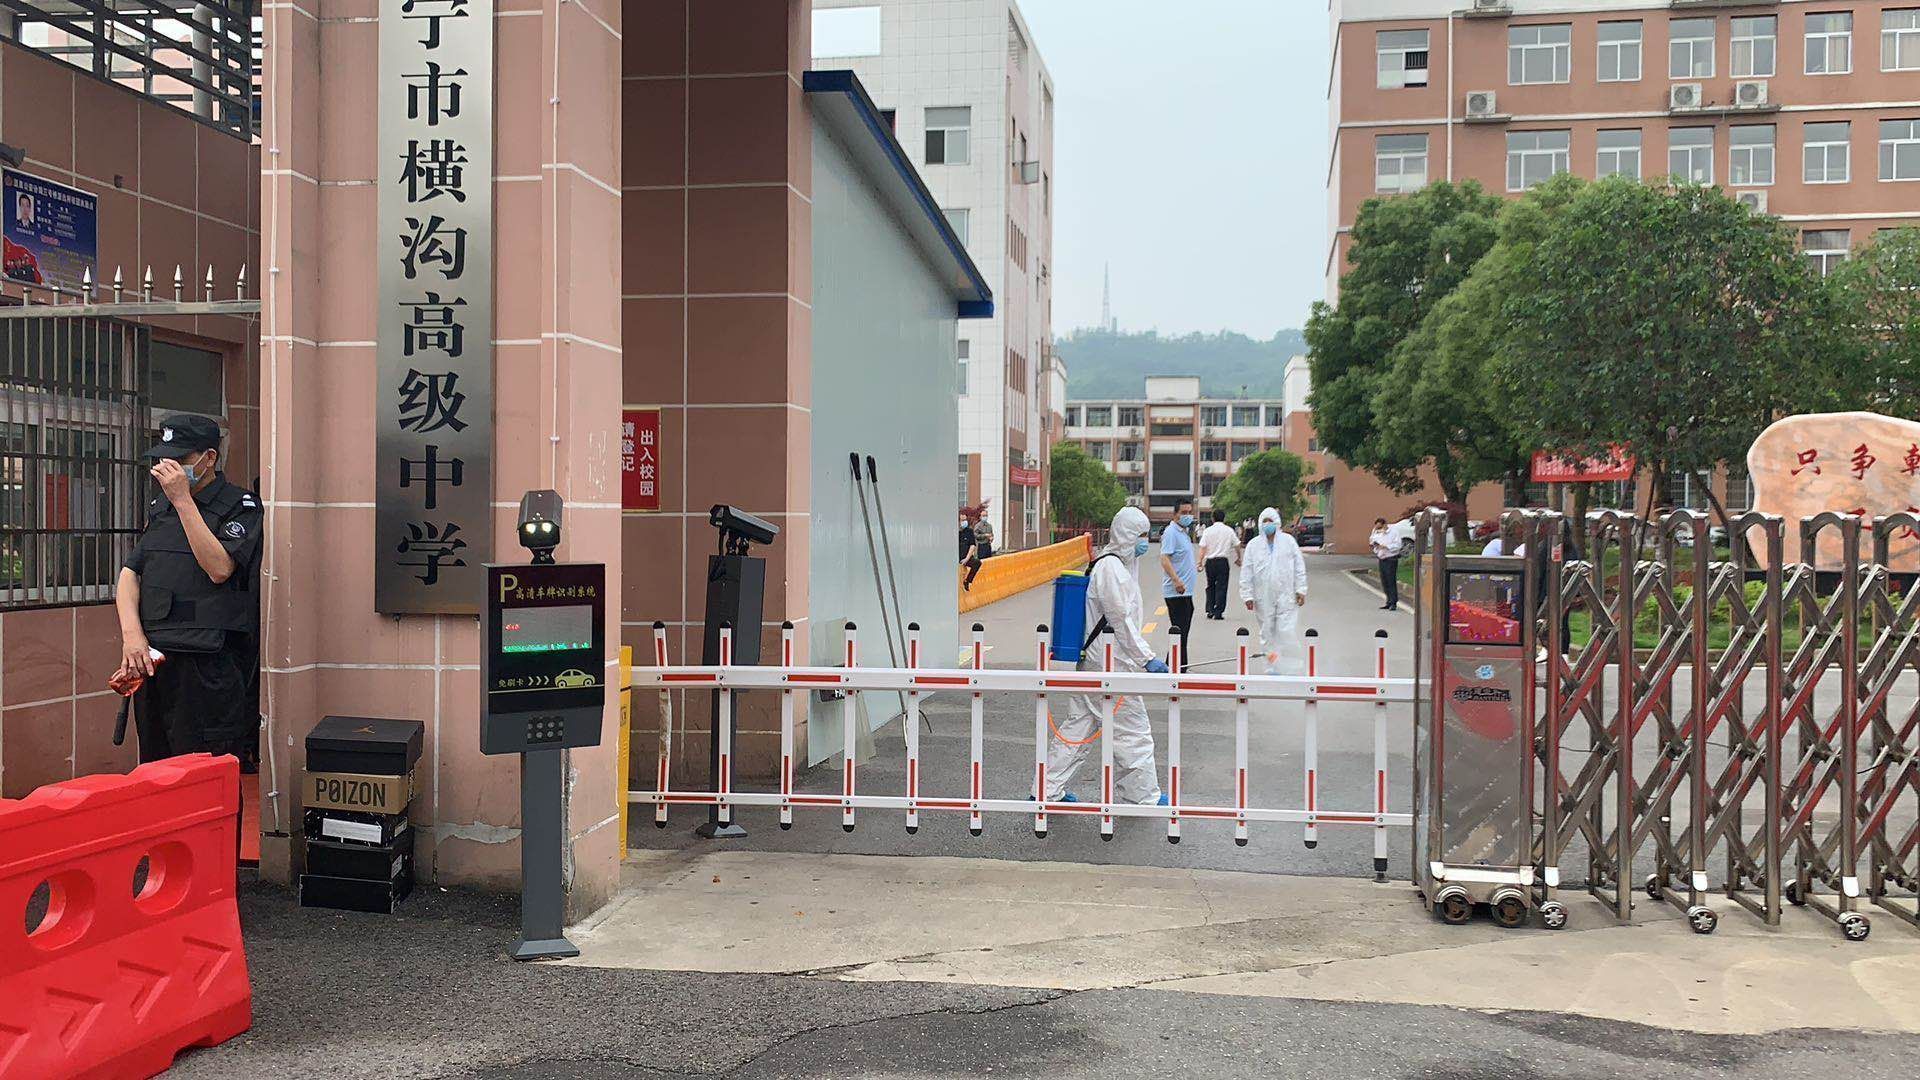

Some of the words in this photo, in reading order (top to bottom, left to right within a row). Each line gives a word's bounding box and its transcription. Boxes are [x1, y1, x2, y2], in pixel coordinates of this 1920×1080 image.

[397, 0, 469, 585] 宁市横沟高级中学
[640, 429, 655, 496] 出入校园
[500, 573, 518, 603] P
[515, 585, 597, 600] 高清车牌识别系统
